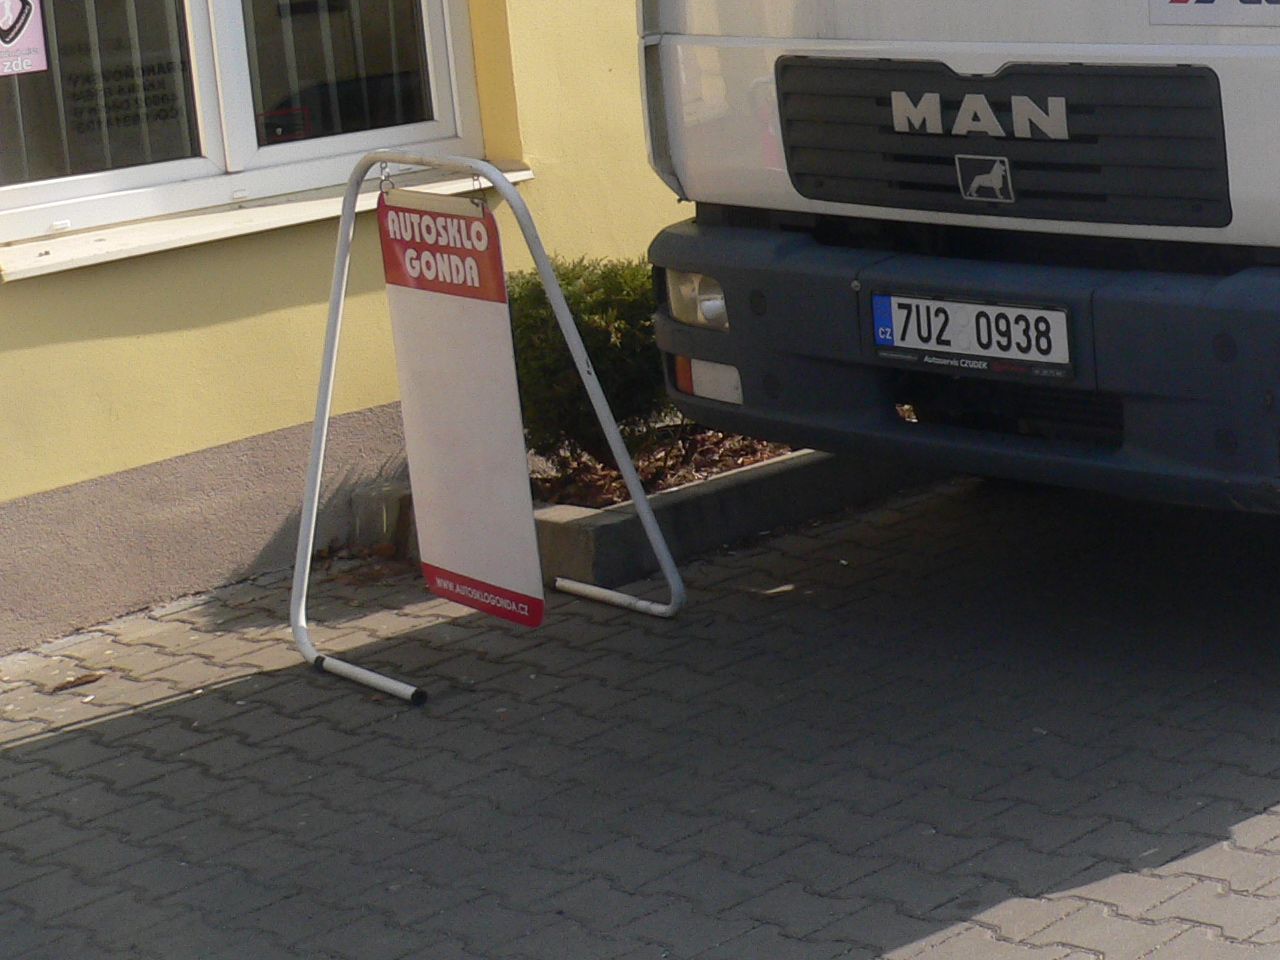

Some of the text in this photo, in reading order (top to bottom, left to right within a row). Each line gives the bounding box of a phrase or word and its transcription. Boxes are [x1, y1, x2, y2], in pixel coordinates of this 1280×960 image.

[3, 56, 33, 72] zde
[891, 91, 1069, 139] MAN
[388, 210, 488, 252] AUTOSKLO
[405, 248, 480, 288] GONDA
[878, 327, 892, 340] CZ
[897, 302, 1052, 356] 7U2 0938
[923, 355, 960, 367] Autoservis
[435, 576, 529, 616] WWW.AUTOSKLOGONDA.CZ
